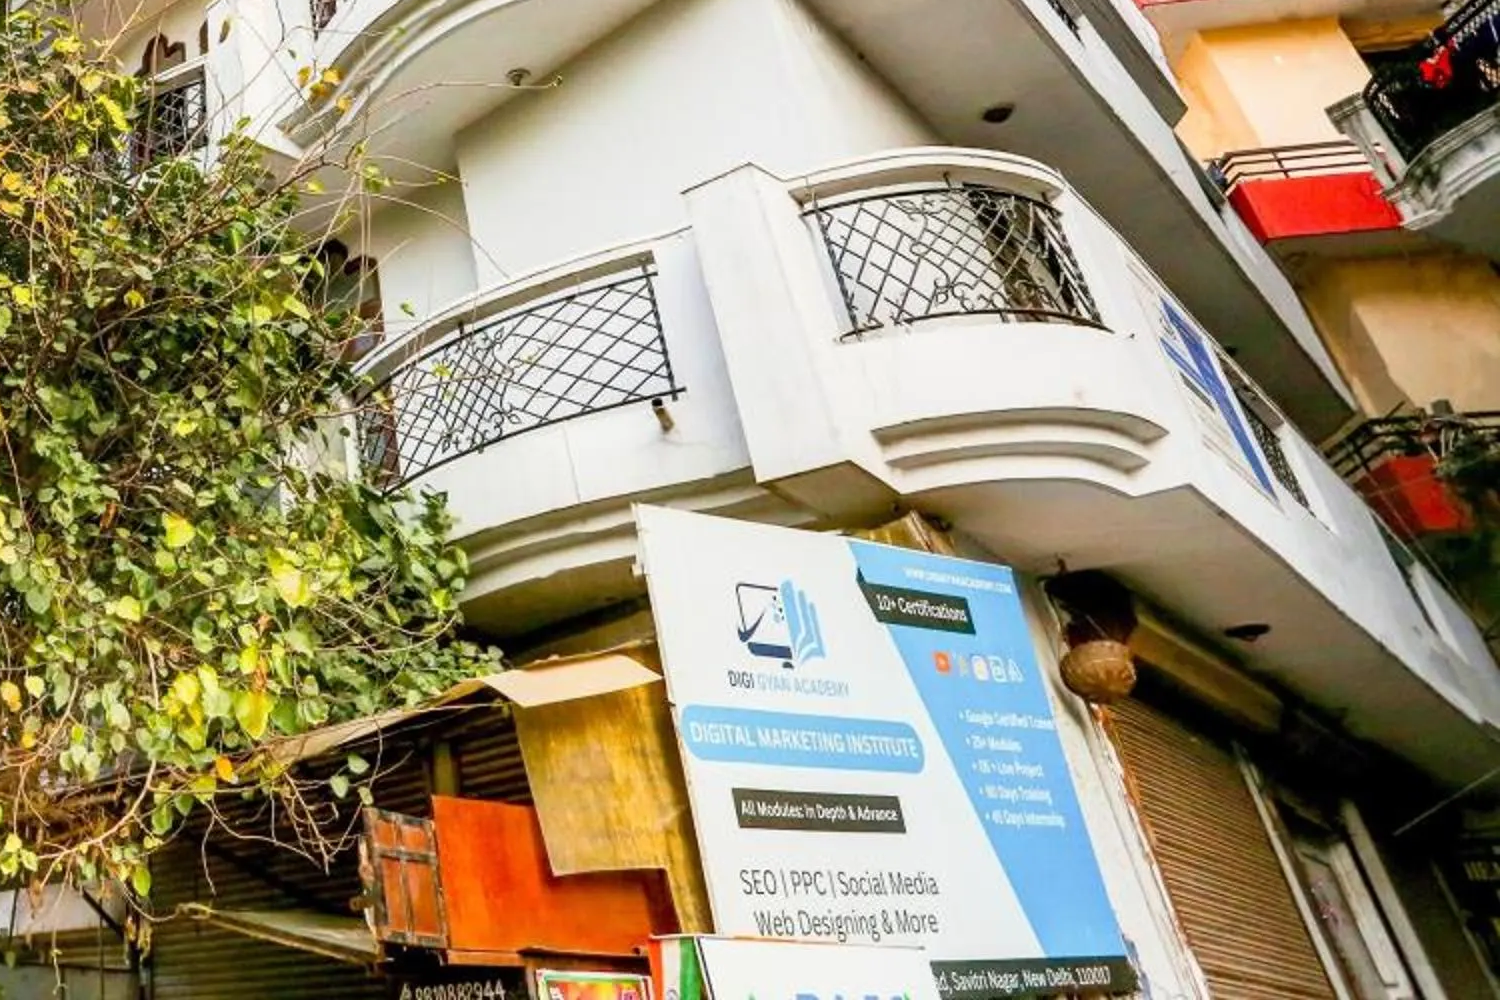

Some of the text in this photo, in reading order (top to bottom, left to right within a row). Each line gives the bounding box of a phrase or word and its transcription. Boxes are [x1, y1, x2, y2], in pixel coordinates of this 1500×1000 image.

[898, 596, 967, 622] Certifications
[728, 670, 755, 689] DIGI
[794, 676, 850, 697] ACADEMY
[689, 722, 919, 758] DIGITAL MARKETING INSTITUTE
[741, 800, 756, 816] All
[816, 803, 846, 822] Depth
[857, 805, 898, 821] Advance
[739, 869, 776, 895] SEO
[790, 870, 827, 896] PPC
[837, 871, 887, 896] Social
[889, 871, 939, 895] Media
[754, 909, 939, 943] Web Designing & More
[952, 970, 988, 991] Savitri
[1022, 970, 1046, 988] New
